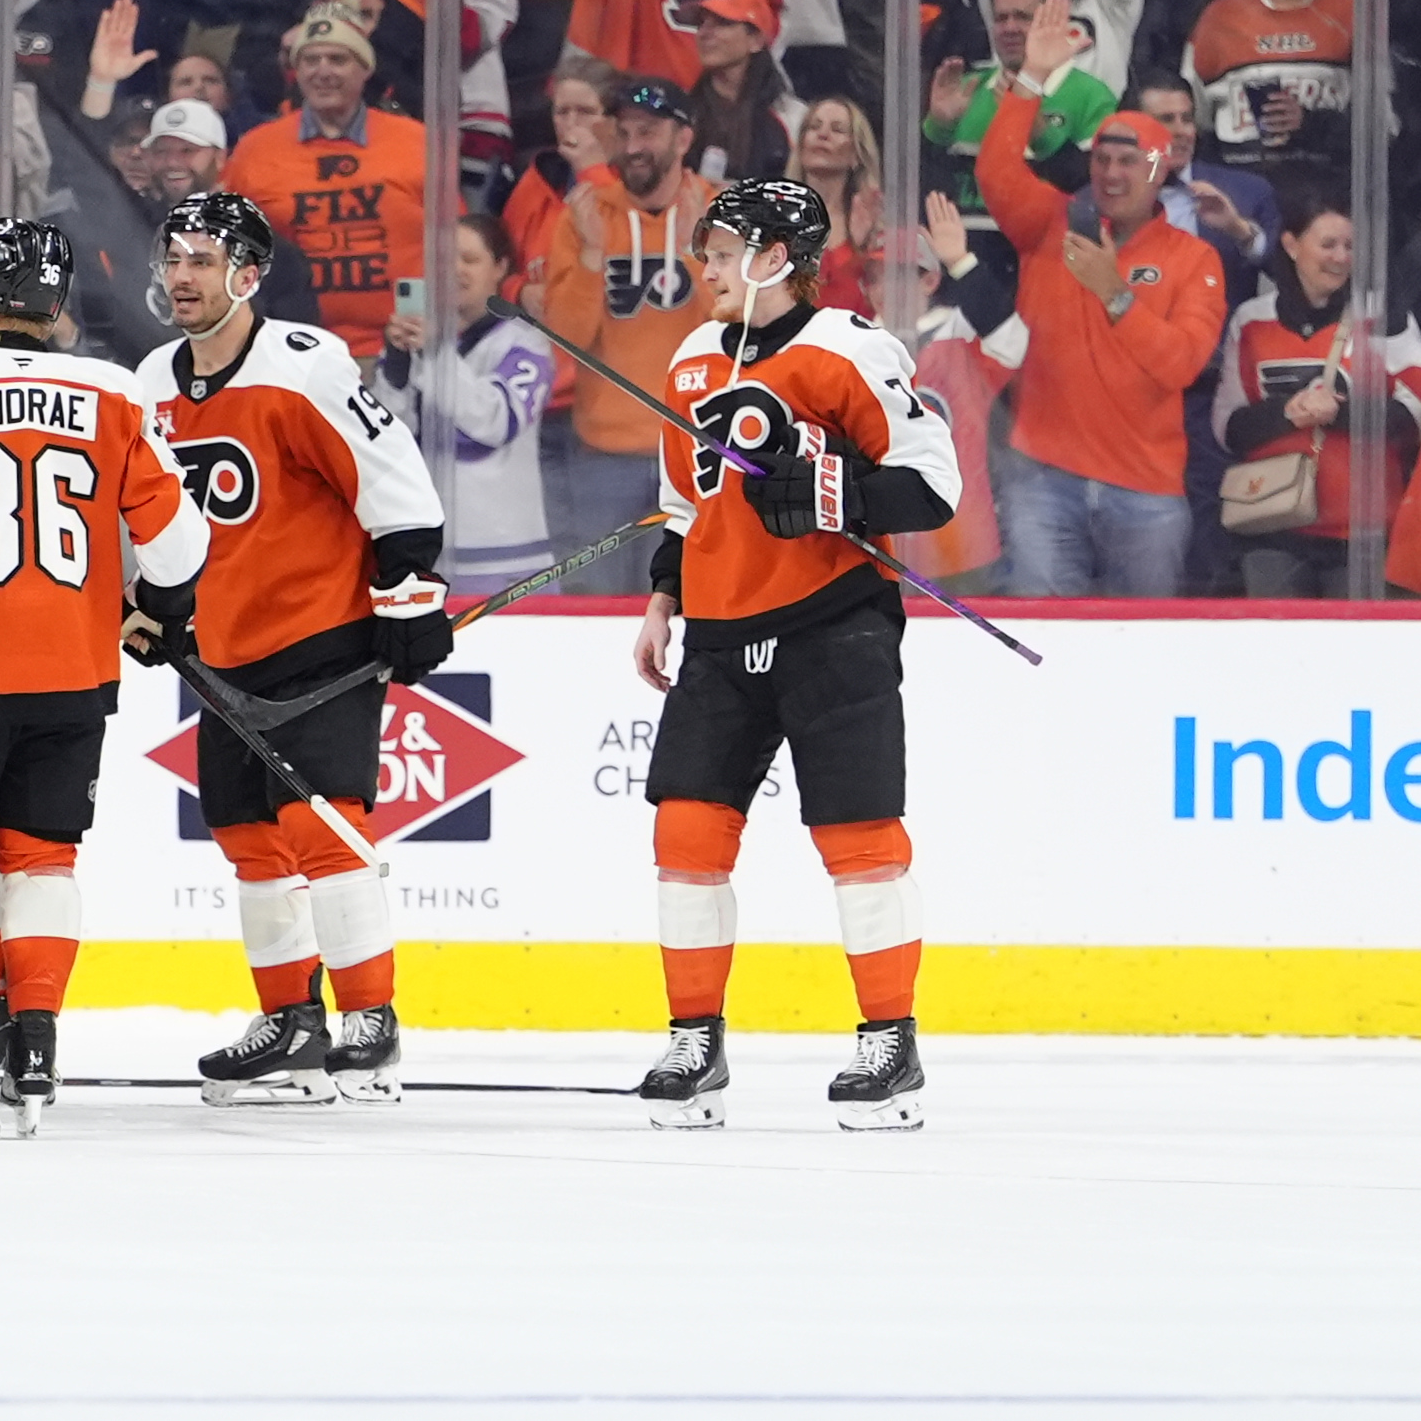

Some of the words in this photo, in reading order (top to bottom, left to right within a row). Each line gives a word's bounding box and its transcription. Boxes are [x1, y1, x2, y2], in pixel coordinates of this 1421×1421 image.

[291, 185, 381, 226] FLY
[292, 226, 386, 252] OR
[39, 263, 60, 286] 36
[308, 253, 391, 293] DIE
[347, 385, 393, 441] 19
[402, 711, 442, 750] &
[1174, 710, 1421, 822] Inde
[174, 887, 226, 910] IT'S
[400, 887, 500, 910] THING
